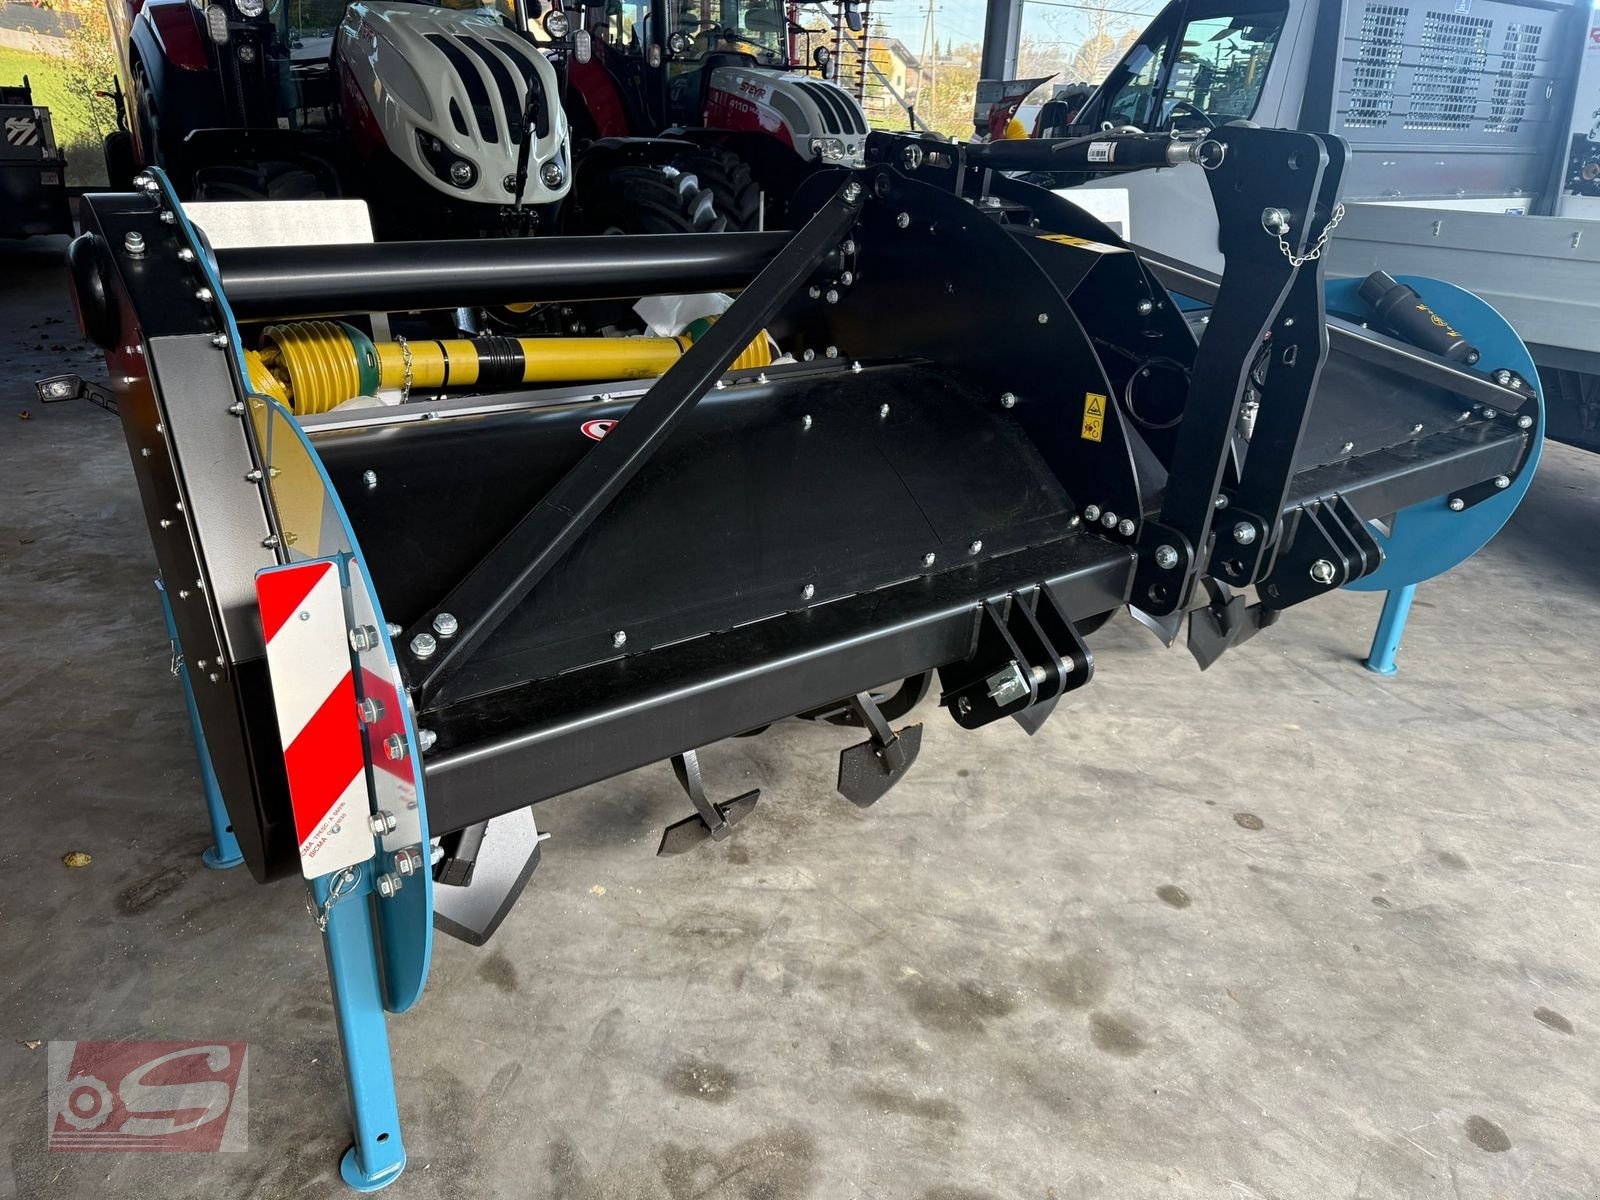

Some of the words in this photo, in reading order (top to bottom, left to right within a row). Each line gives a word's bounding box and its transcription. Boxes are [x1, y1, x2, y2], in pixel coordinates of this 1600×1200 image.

[738, 81, 767, 99] STEYR
[729, 99, 749, 113] 4110
[309, 837, 327, 858] BICMA
